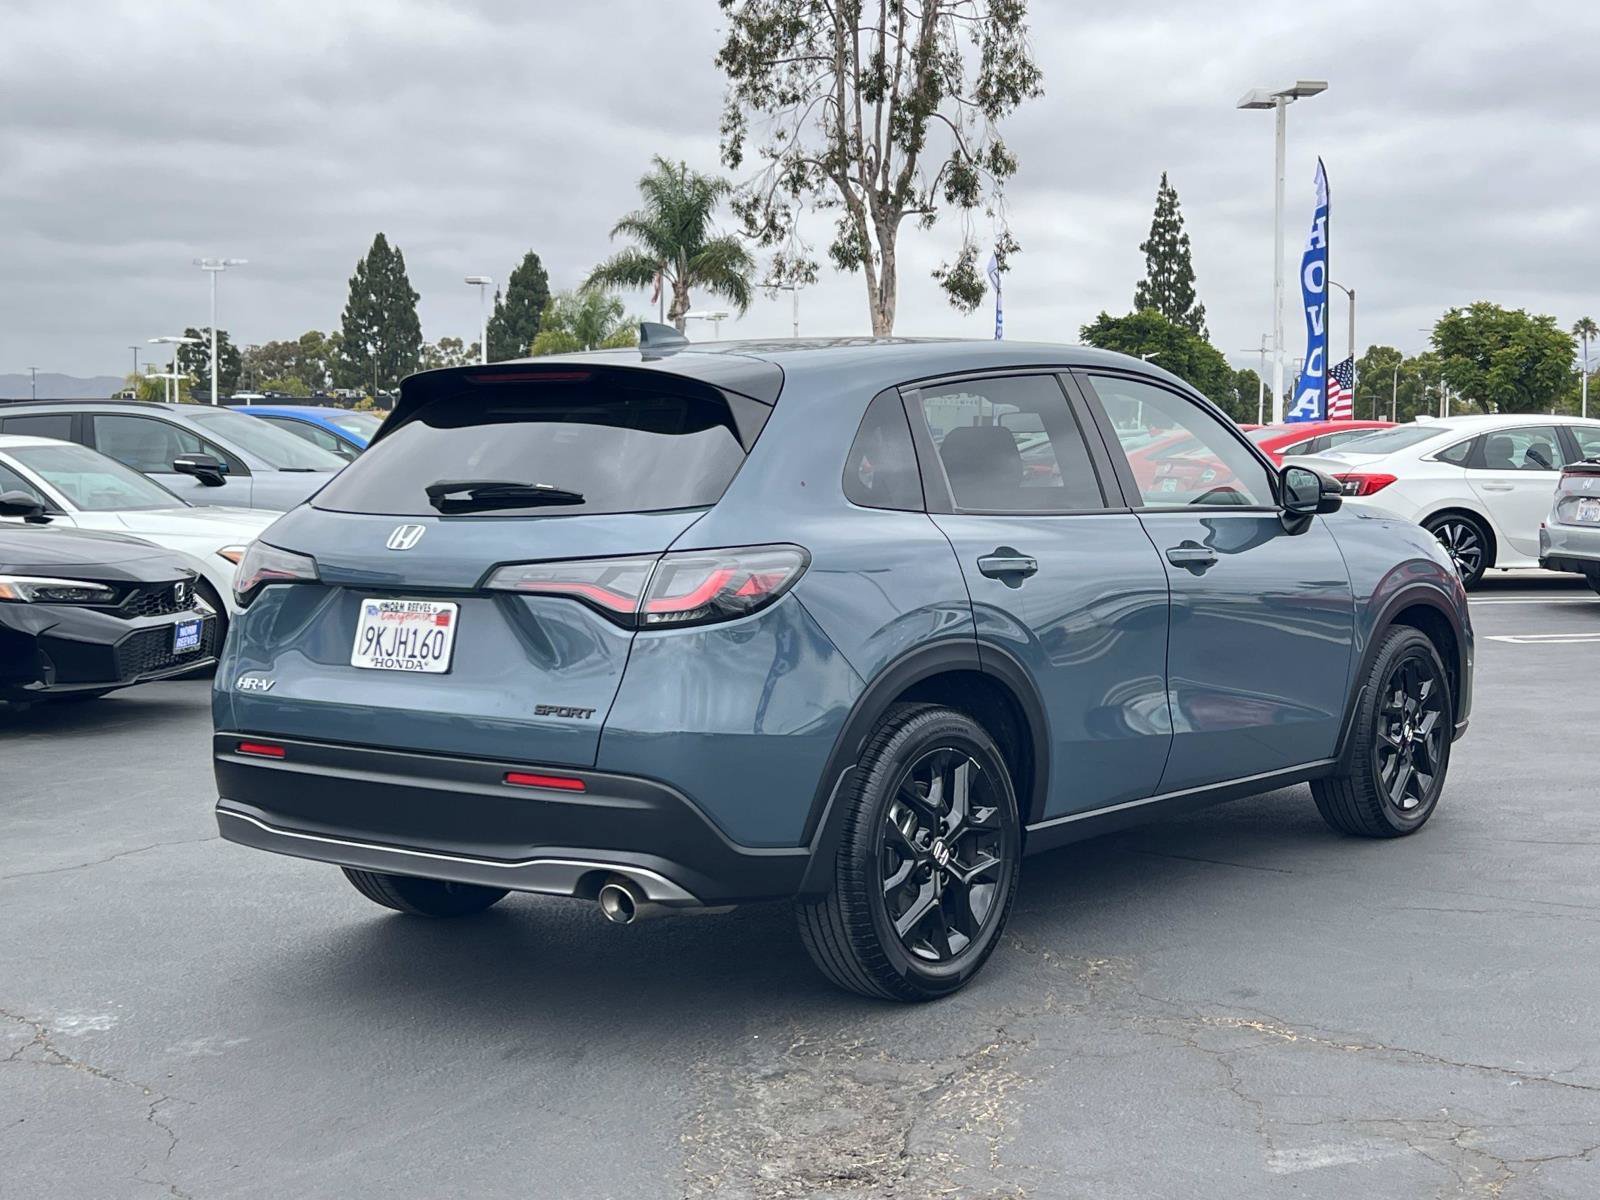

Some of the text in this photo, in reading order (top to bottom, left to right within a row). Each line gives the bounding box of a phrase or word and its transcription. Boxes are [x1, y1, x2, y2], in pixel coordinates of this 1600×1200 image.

[407, 602, 432, 613] REEVES
[362, 626, 445, 661] 9KJH160
[374, 658, 424, 670] HONDA
[237, 677, 276, 692] HR-V
[534, 704, 597, 719] SPORT
